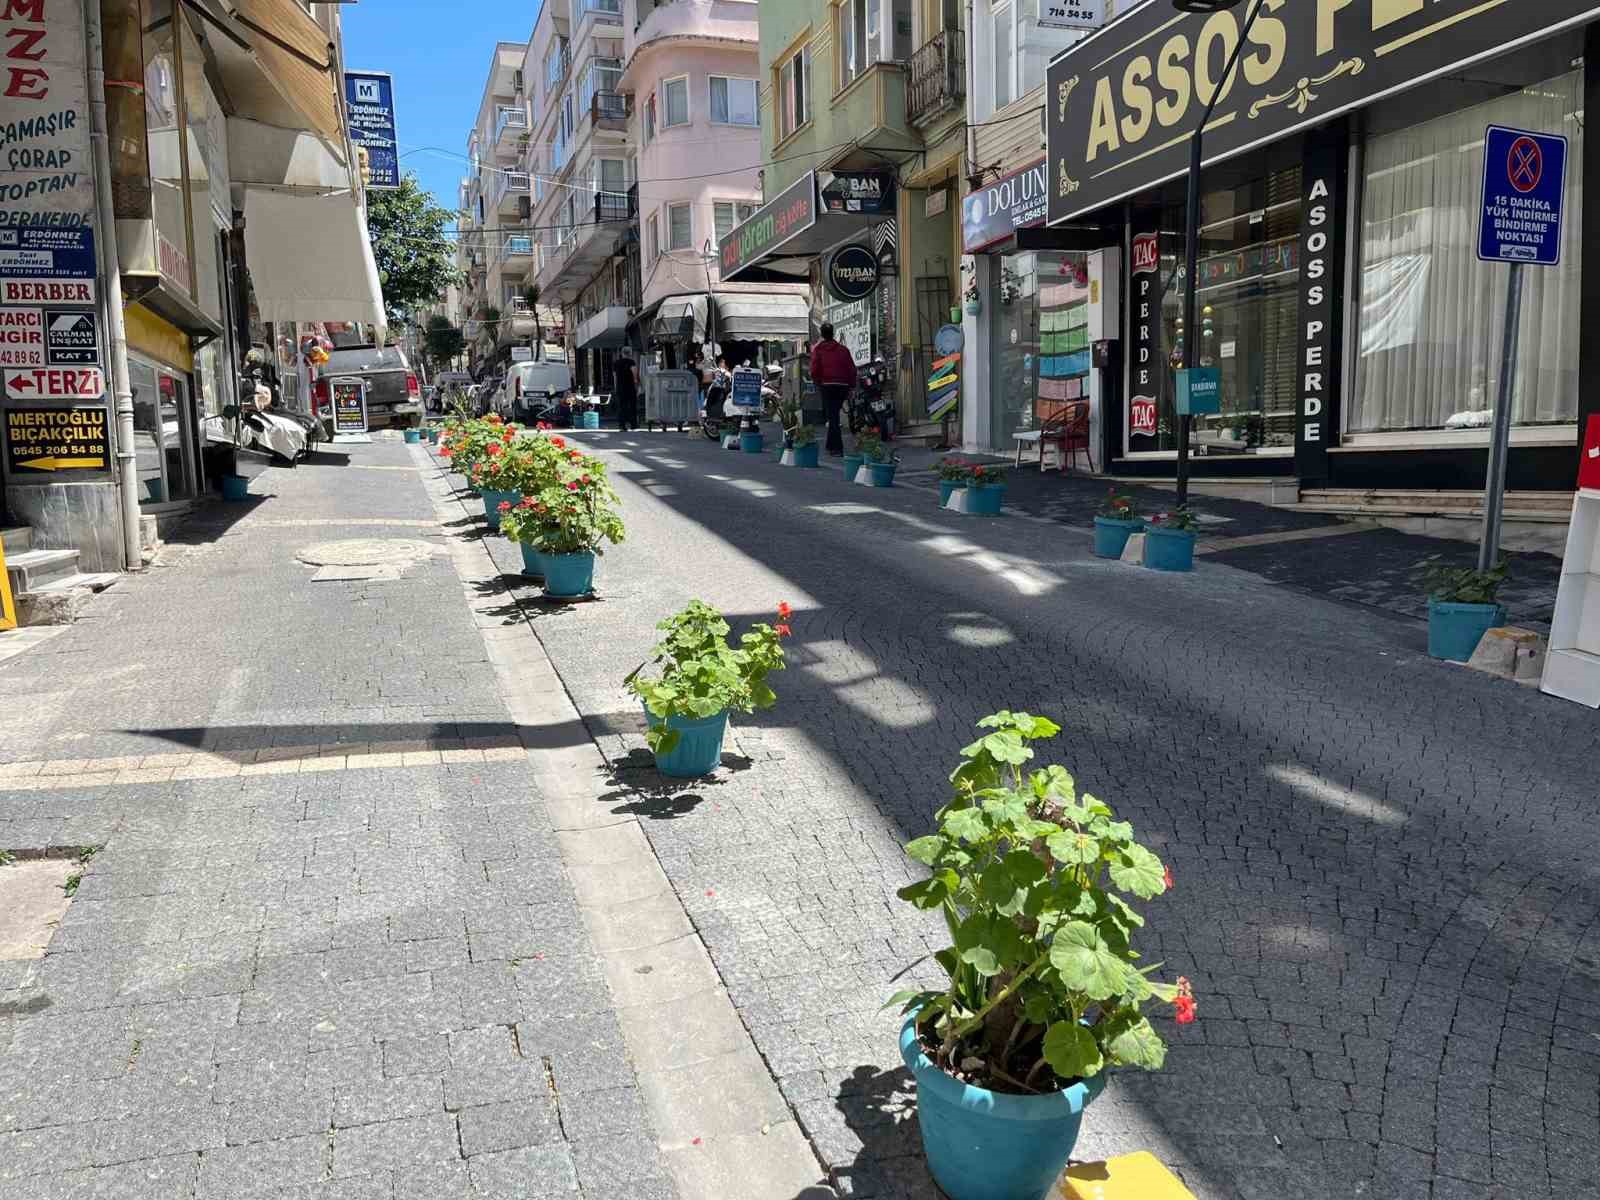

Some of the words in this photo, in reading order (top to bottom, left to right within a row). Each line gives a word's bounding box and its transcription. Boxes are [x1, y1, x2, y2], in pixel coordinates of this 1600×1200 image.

[1086, 0, 1286, 162] ASSOS
[8, 148, 71, 171] ÇORAP
[0, 172, 77, 202] TOPTAN
[1494, 195, 1507, 206] 15
[1510, 197, 1550, 211] DAKİKA
[1486, 205, 1509, 218] YÜK
[1512, 207, 1558, 223] İNDİRME
[1494, 217, 1547, 233] BİNDİRME
[23, 229, 81, 240] ERDÖNMEZ
[1307, 178, 1328, 306] ASOSS
[1496, 230, 1543, 244] NOKTASI
[6, 282, 91, 301] BERBER
[0, 312, 41, 327] TARCI
[1139, 279, 1149, 385] PERDE
[56, 352, 81, 360] KAT
[86, 352, 92, 360] 1
[1304, 320, 1323, 442] PERDE
[9, 408, 105, 426] MERTOĞLU
[10, 426, 105, 444] BIÇAKÇILIK
[46, 446, 68, 455] 206
[71, 445, 86, 454] 54
[89, 445, 105, 454] 88
